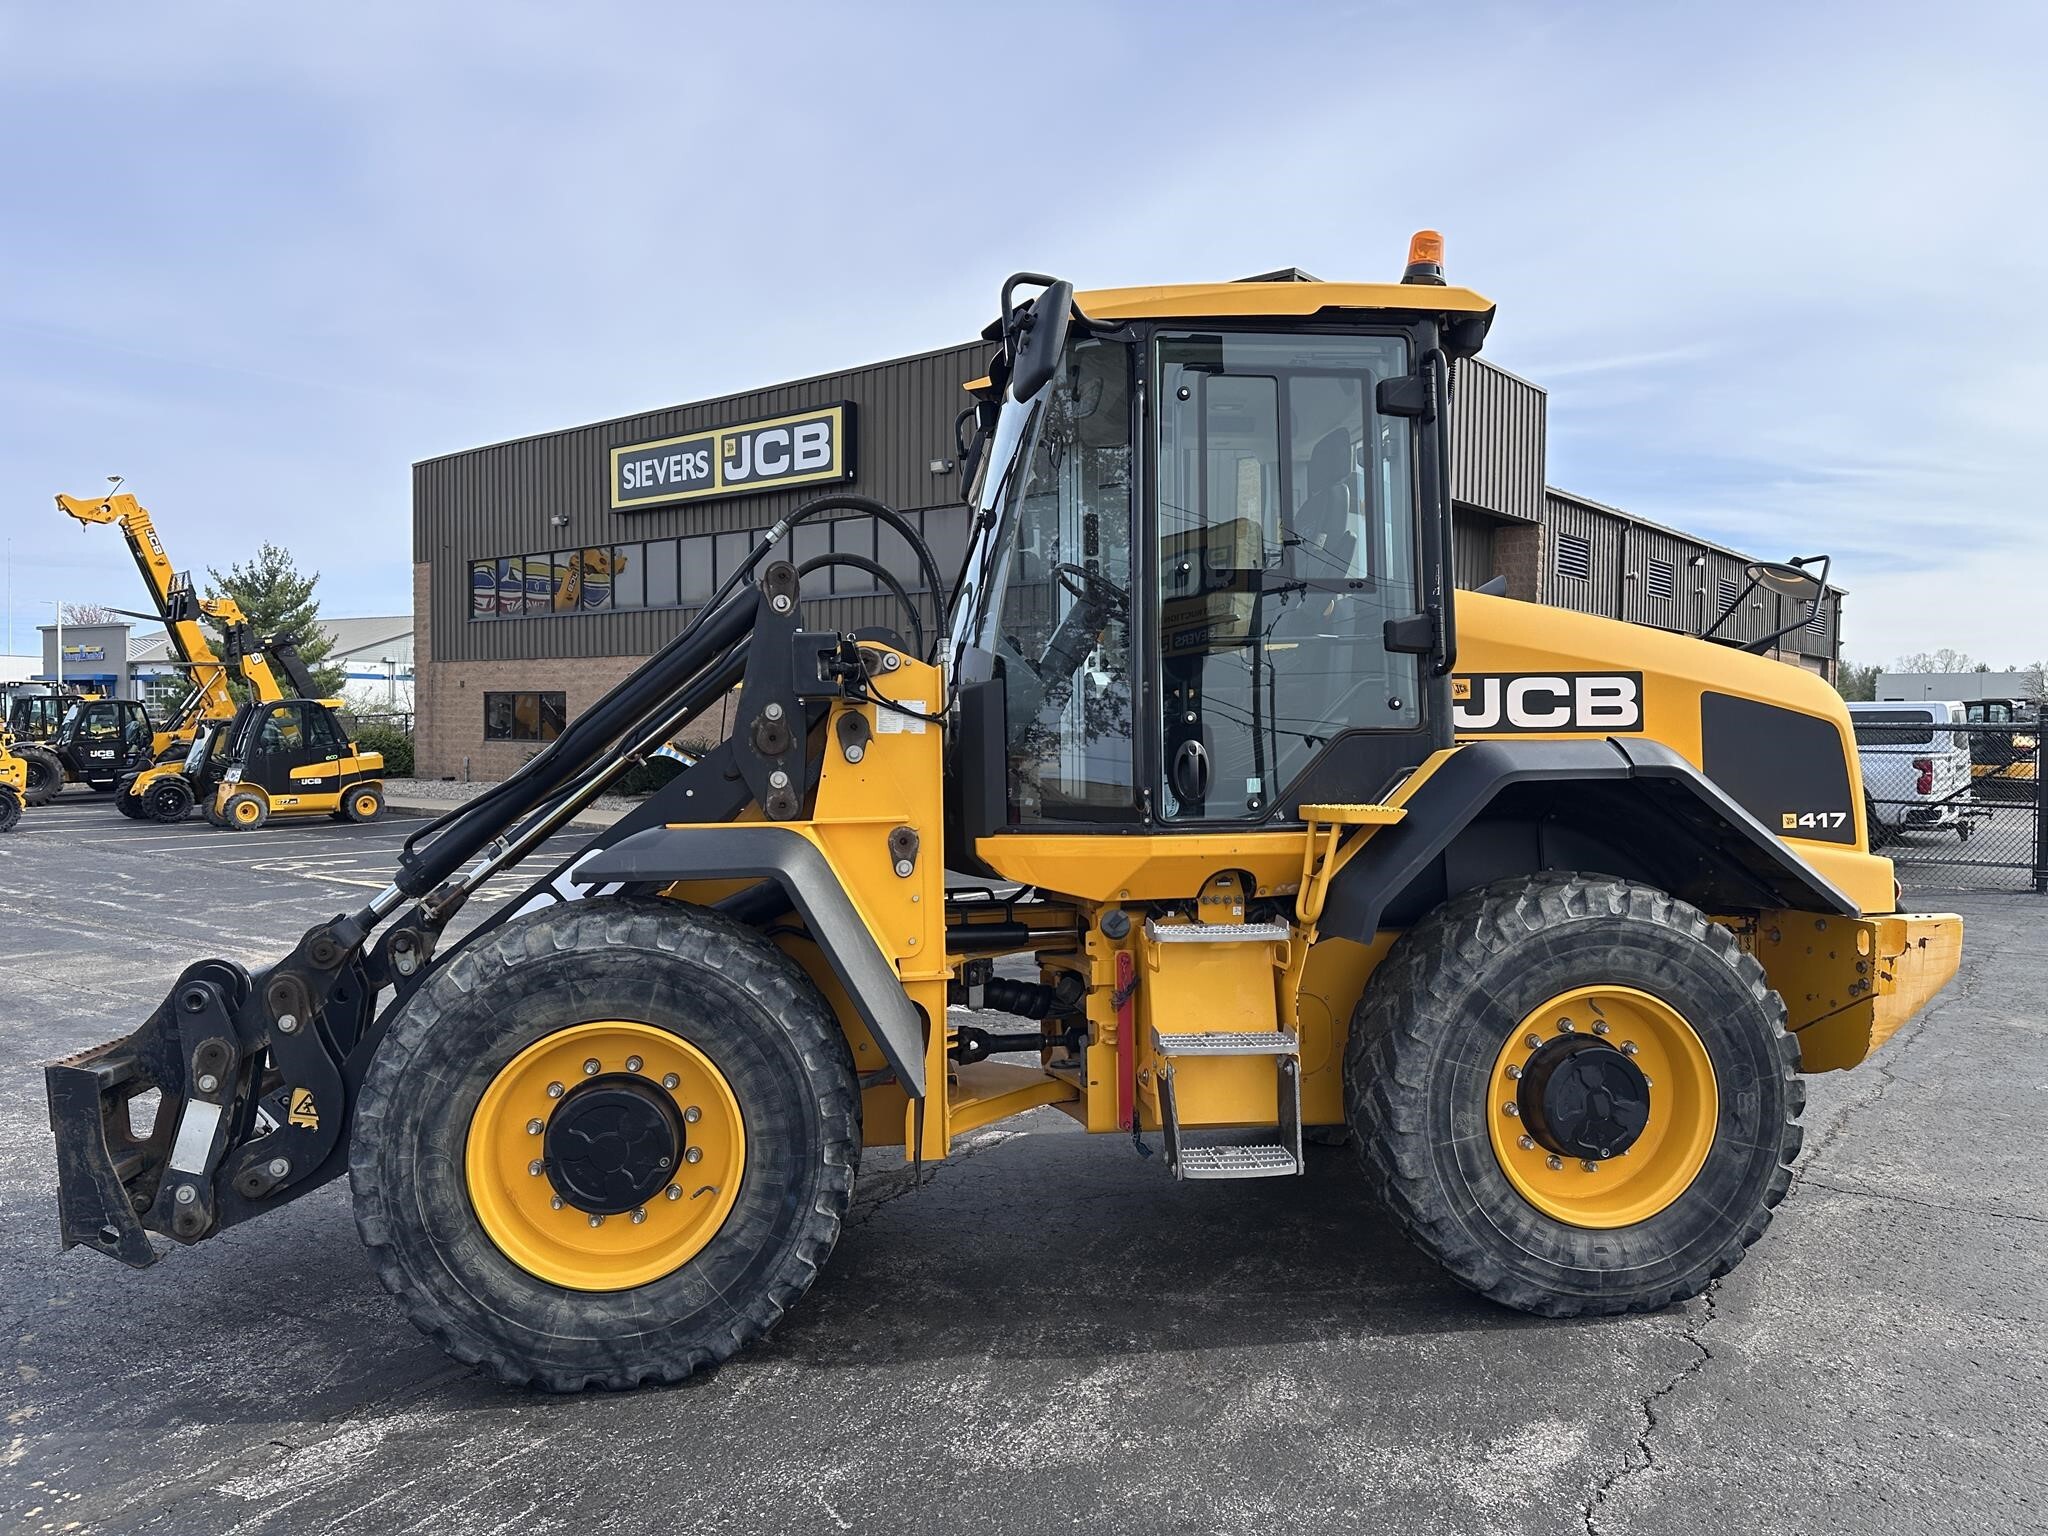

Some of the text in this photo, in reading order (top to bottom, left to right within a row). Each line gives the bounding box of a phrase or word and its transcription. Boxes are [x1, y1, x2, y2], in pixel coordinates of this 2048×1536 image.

[622, 422, 831, 490] SIEVERS JCB
[145, 529, 163, 555] JCB
[1453, 677, 1639, 728] JCB
[90, 750, 115, 758] JCB
[1799, 813, 1846, 828] 417
